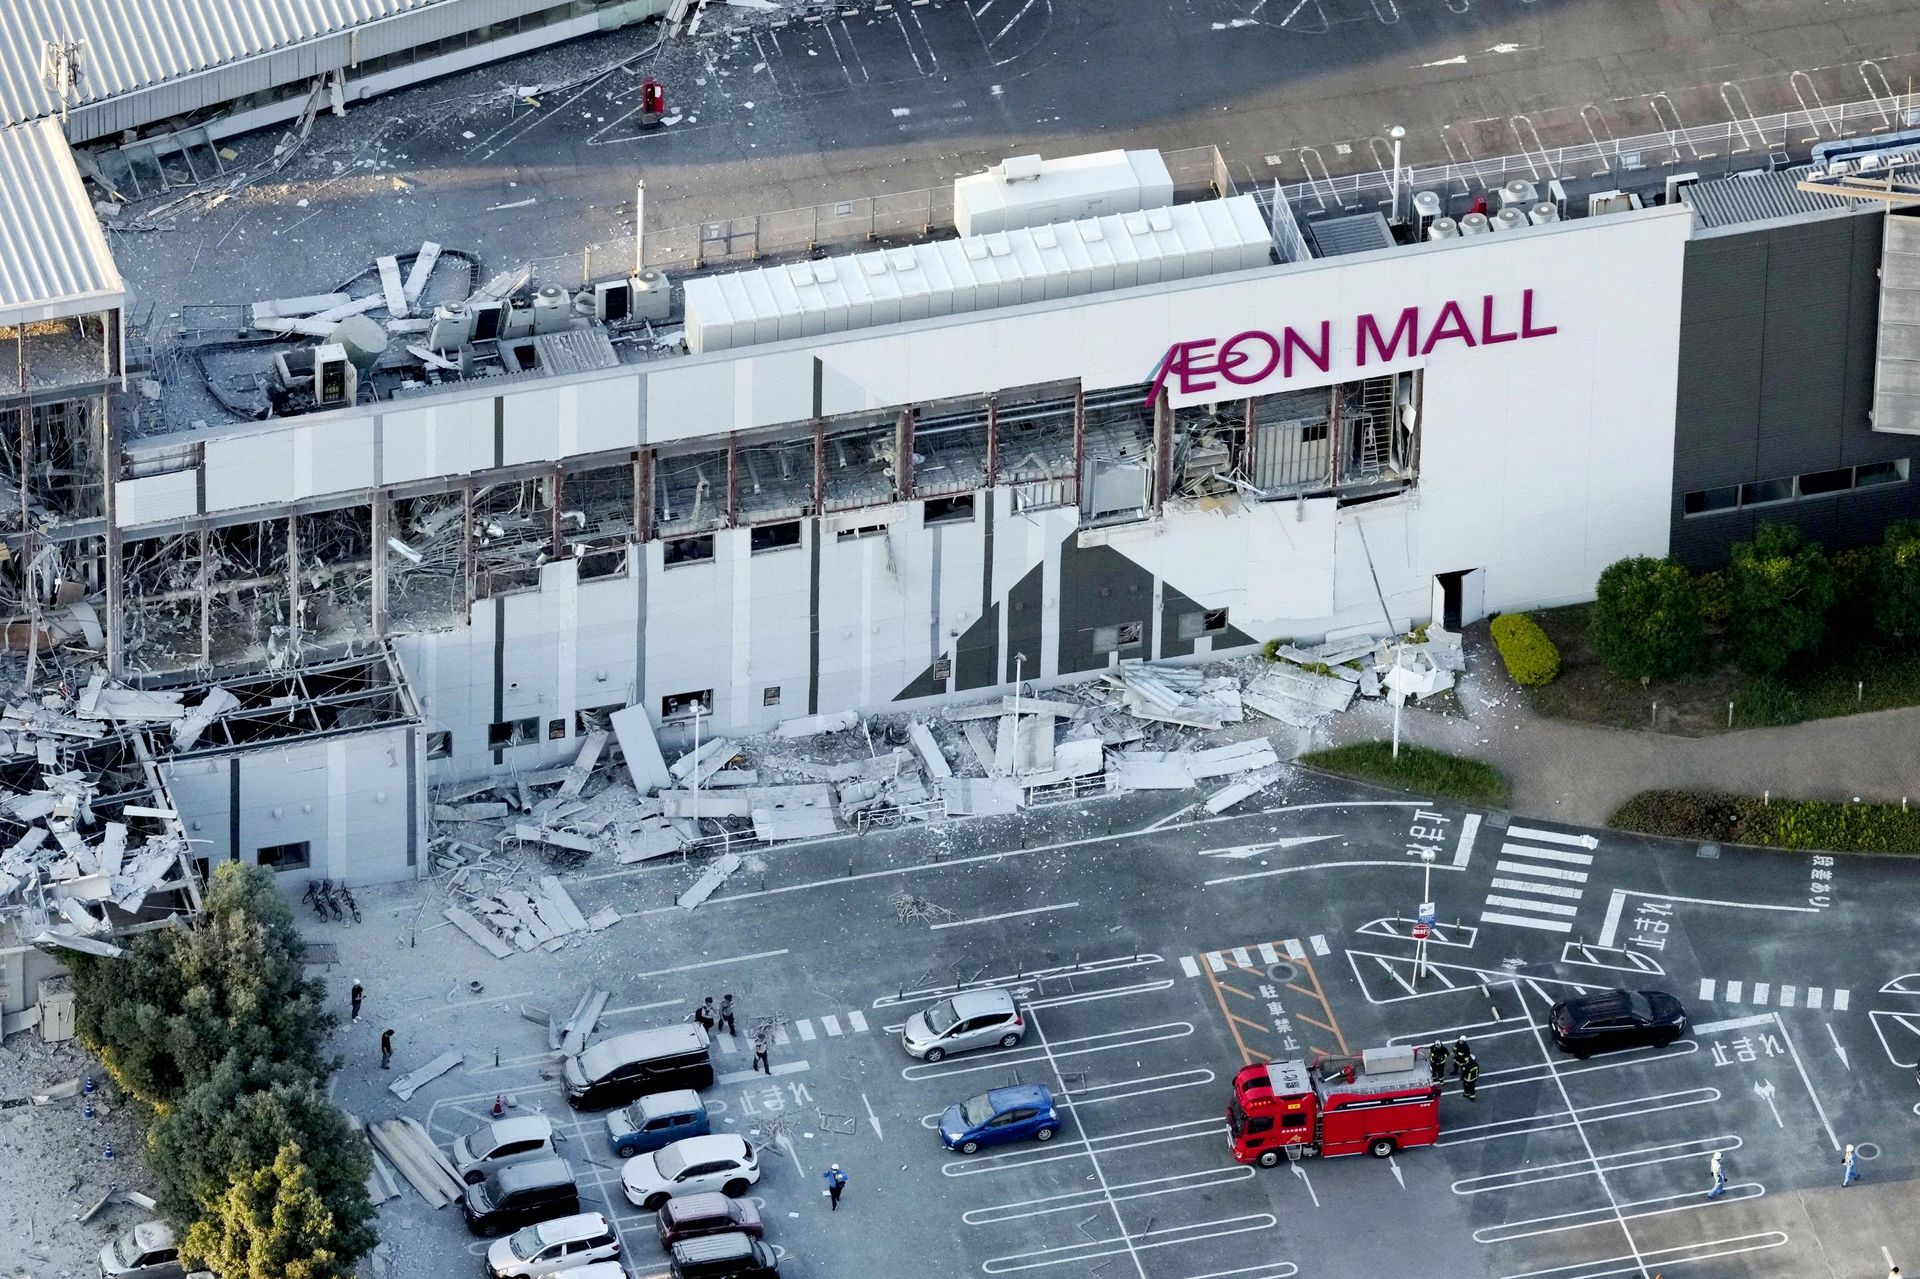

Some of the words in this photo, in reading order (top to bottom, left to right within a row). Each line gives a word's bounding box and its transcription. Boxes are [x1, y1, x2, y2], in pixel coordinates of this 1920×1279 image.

[1145, 320, 1330, 407] AEON
[1356, 289, 1557, 366] MALL
[1809, 855, 1834, 907] 段差あり
[1628, 902, 1673, 951] 止まれ
[1259, 985, 1300, 1050] 駐車禁止
[1711, 1034, 1784, 1067] 止まれ
[740, 1082, 813, 1115] 止まれ
